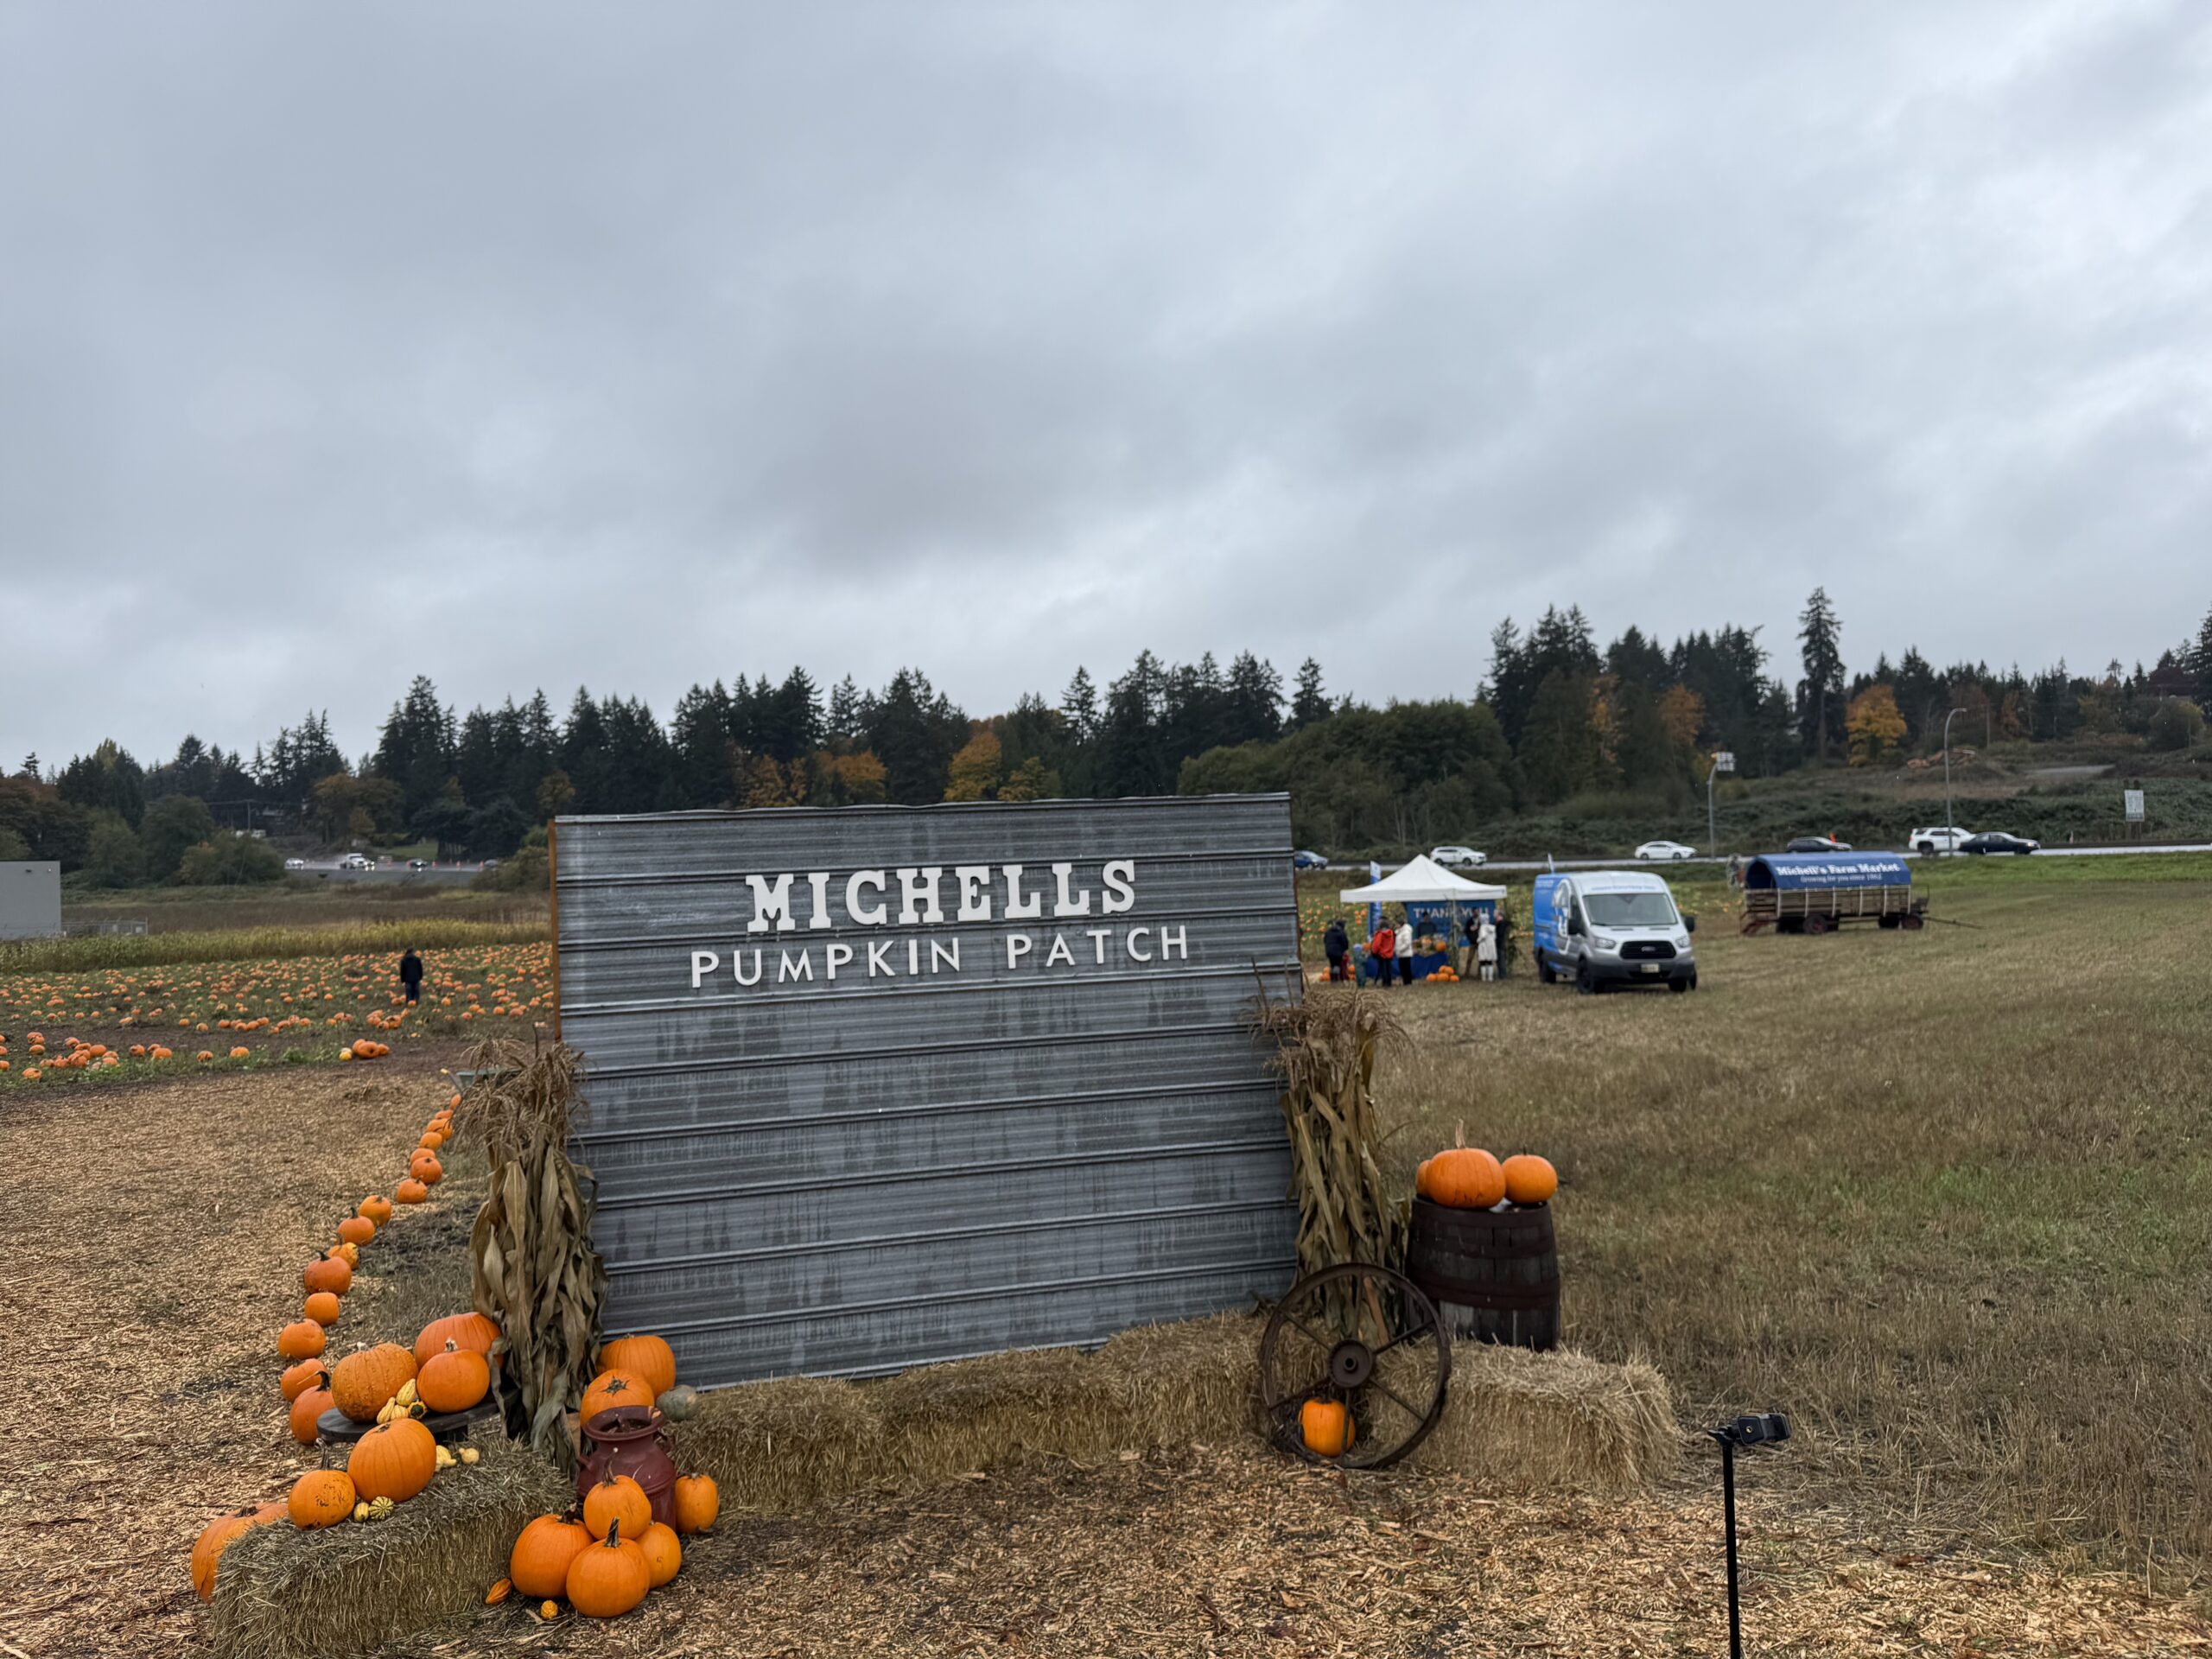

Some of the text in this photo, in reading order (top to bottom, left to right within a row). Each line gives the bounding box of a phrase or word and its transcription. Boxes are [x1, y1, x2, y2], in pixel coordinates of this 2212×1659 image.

[1776, 862, 1900, 876] Michell's Farm Market
[745, 860, 1136, 932] MICHELLS
[1413, 906, 1489, 918] TAN YU
[691, 925, 1189, 988] PUMPKIN PATCH
